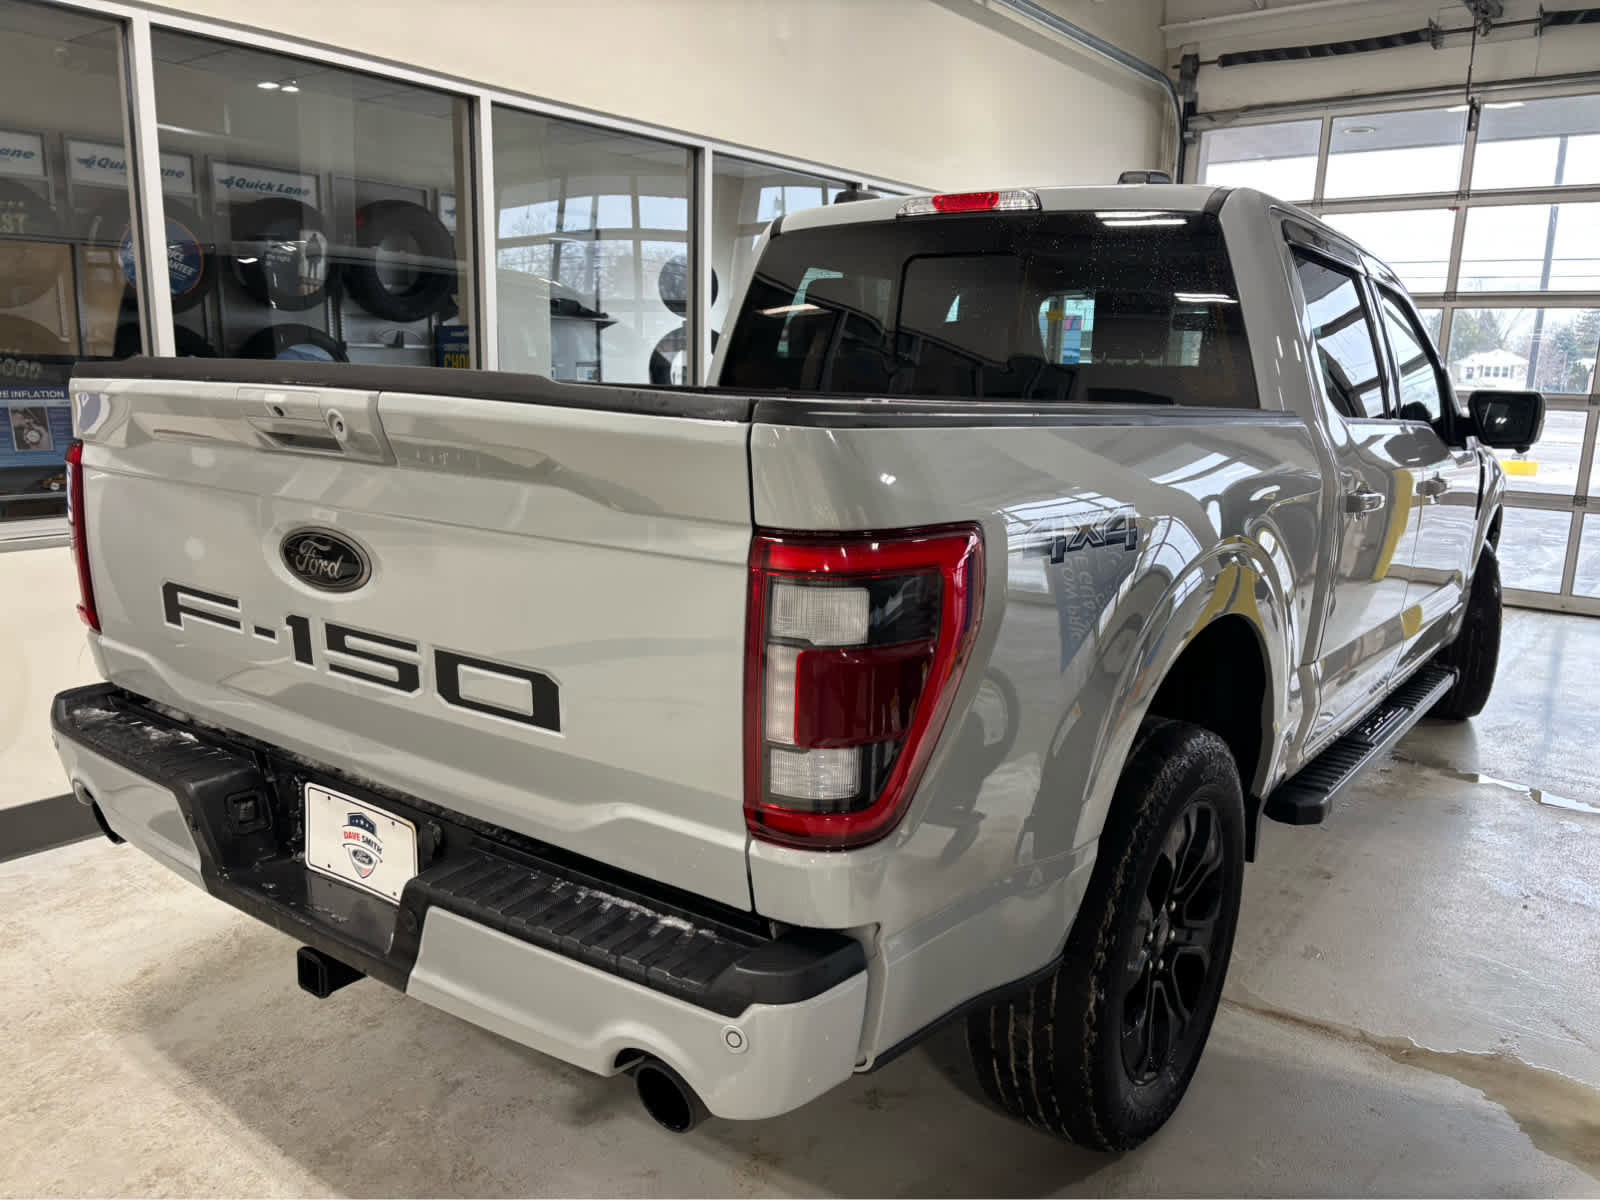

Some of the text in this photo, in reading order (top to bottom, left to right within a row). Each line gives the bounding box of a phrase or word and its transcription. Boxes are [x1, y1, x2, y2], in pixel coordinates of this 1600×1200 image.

[0, 147, 35, 159] ane
[236, 177, 310, 197] Quick Lane
[11, 389, 65, 399] INFLATION
[295, 539, 345, 580] Ford
[161, 579, 561, 733] F-150
[343, 831, 383, 855] DAVE SMITH
